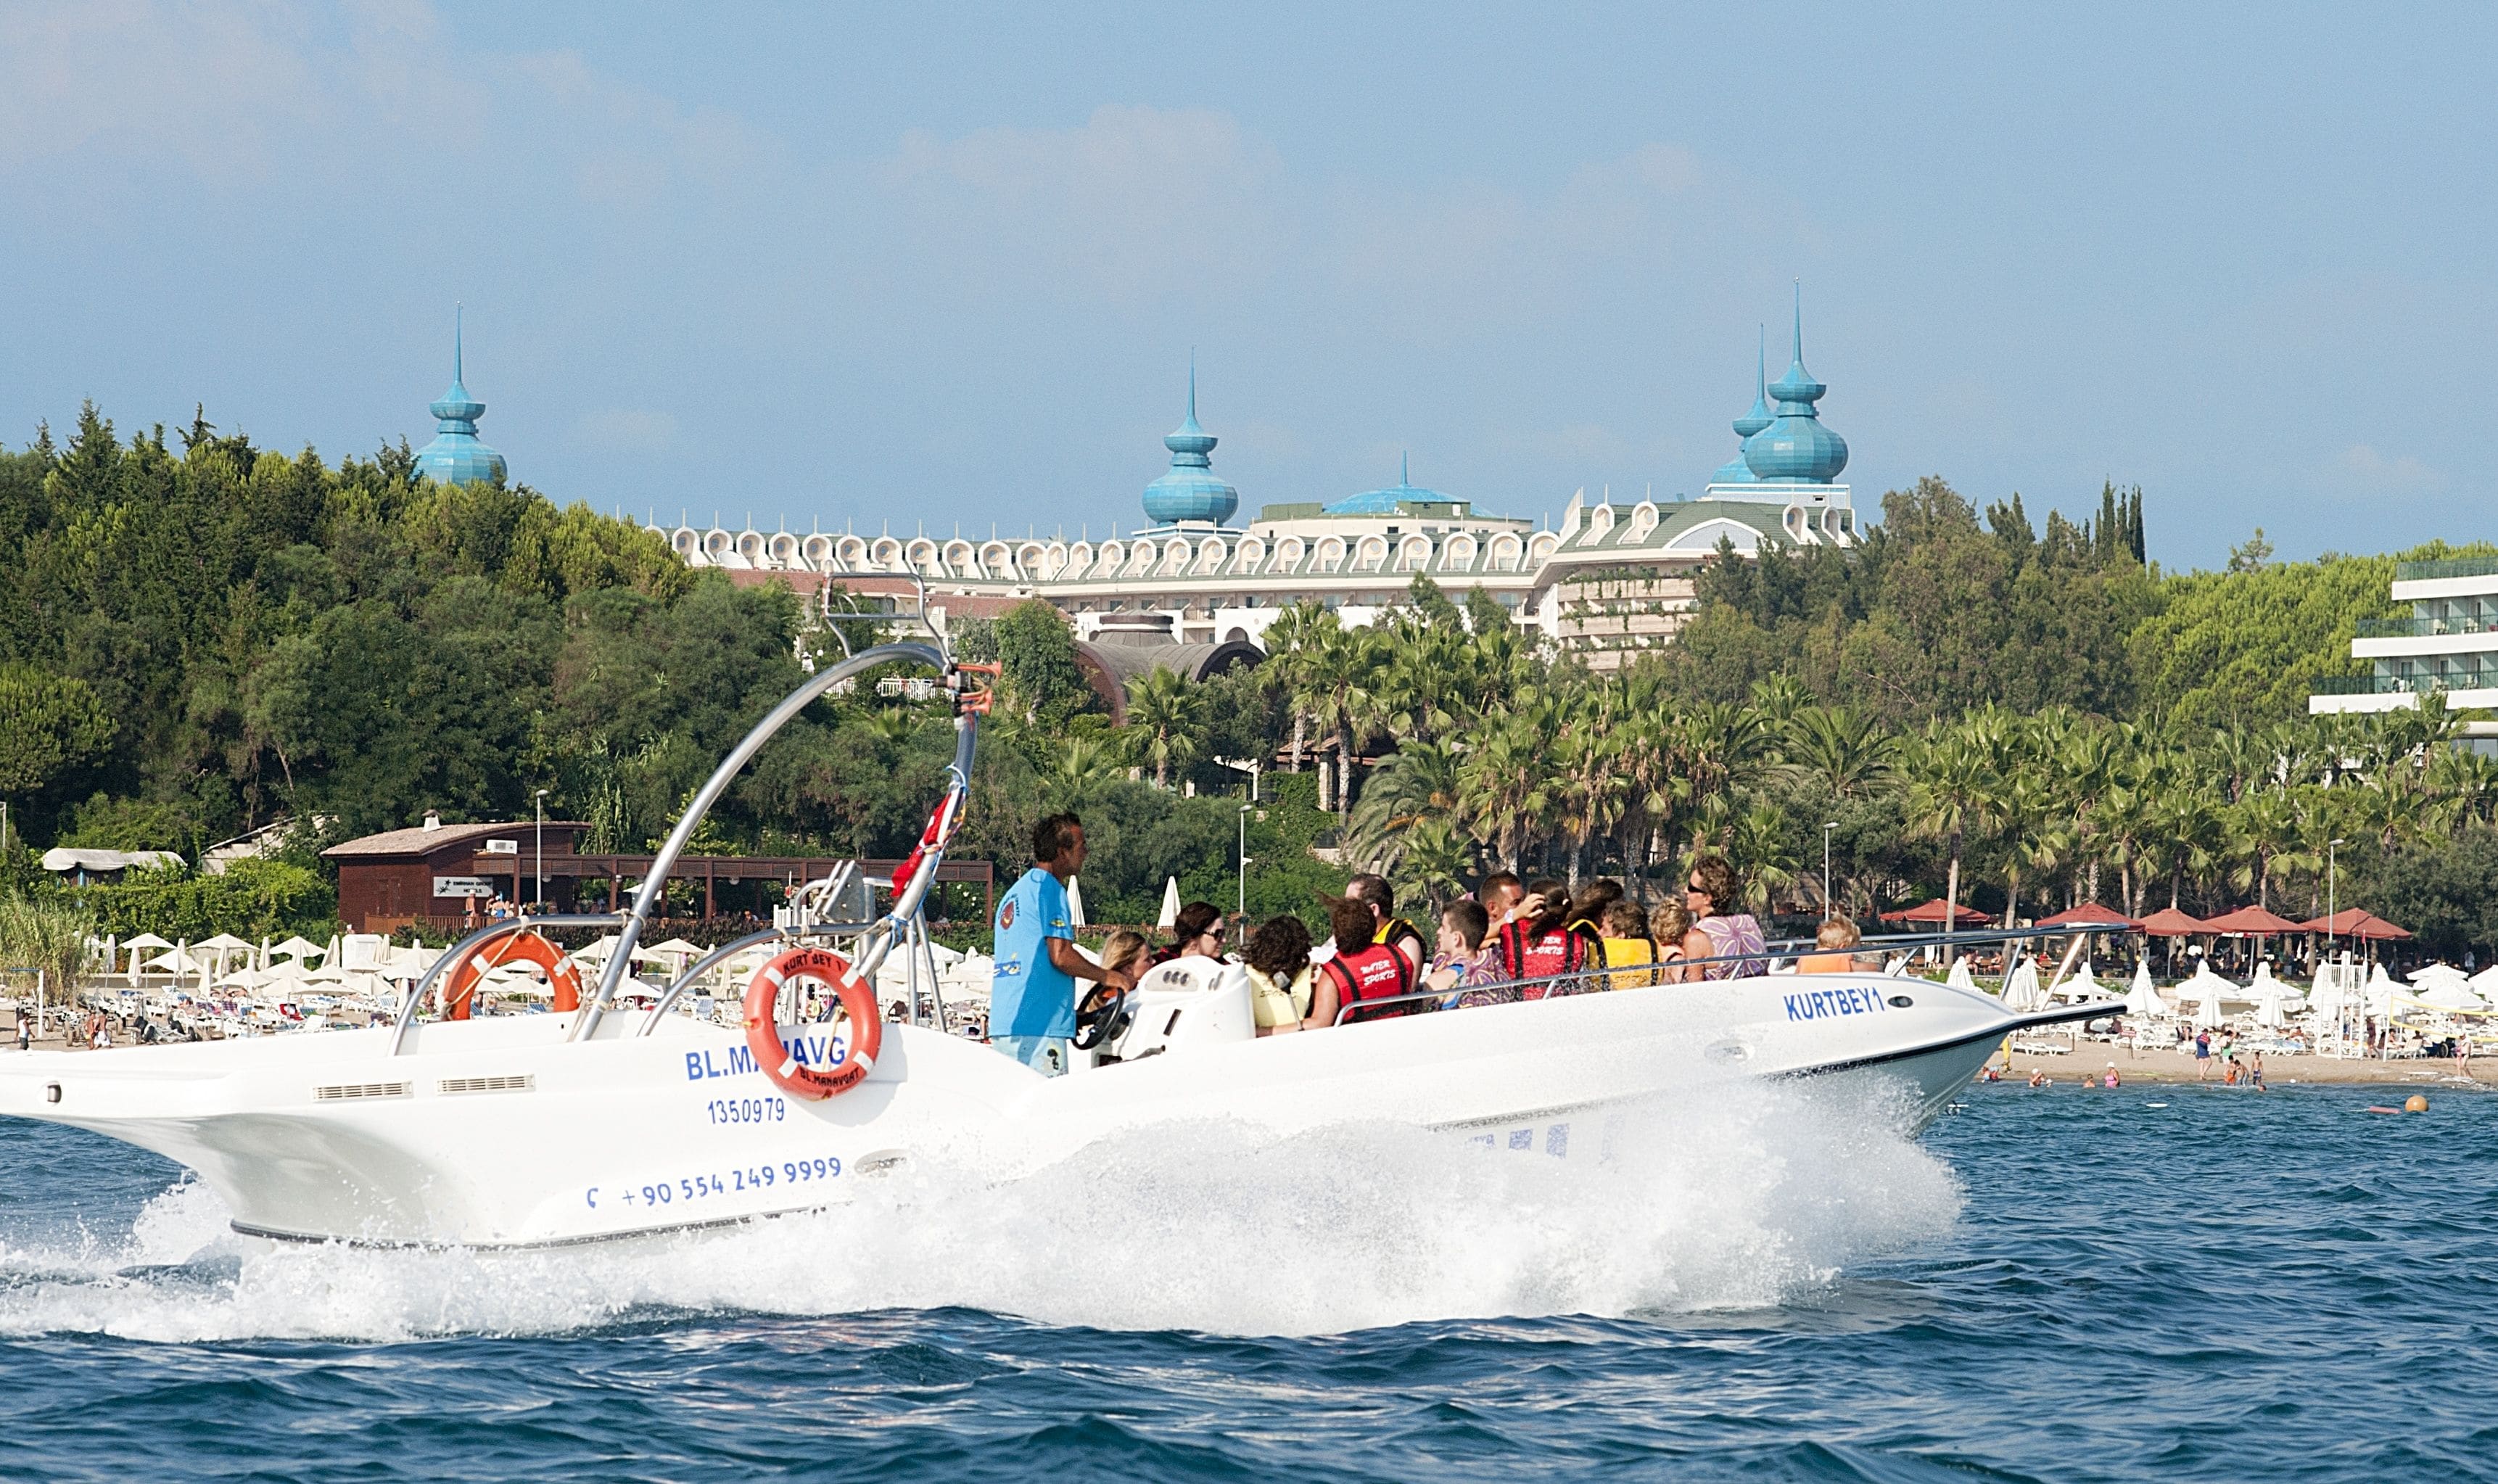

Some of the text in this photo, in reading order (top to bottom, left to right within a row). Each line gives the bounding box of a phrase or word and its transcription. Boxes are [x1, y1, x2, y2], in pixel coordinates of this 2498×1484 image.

[1543, 936, 1562, 944] TER
[783, 954, 808, 974] KURT
[812, 953, 831, 968] BEY
[1360, 959, 1390, 974] WATER
[1364, 969, 1396, 986] SPORTS
[1784, 986, 1885, 1021] KURTBEY1
[800, 1067, 859, 1087] BL.MANAVGAT
[708, 1097, 786, 1124] 1350979
[681, 1174, 725, 1200] 554
[733, 1166, 775, 1191] 249
[784, 1157, 842, 1184] 9999
